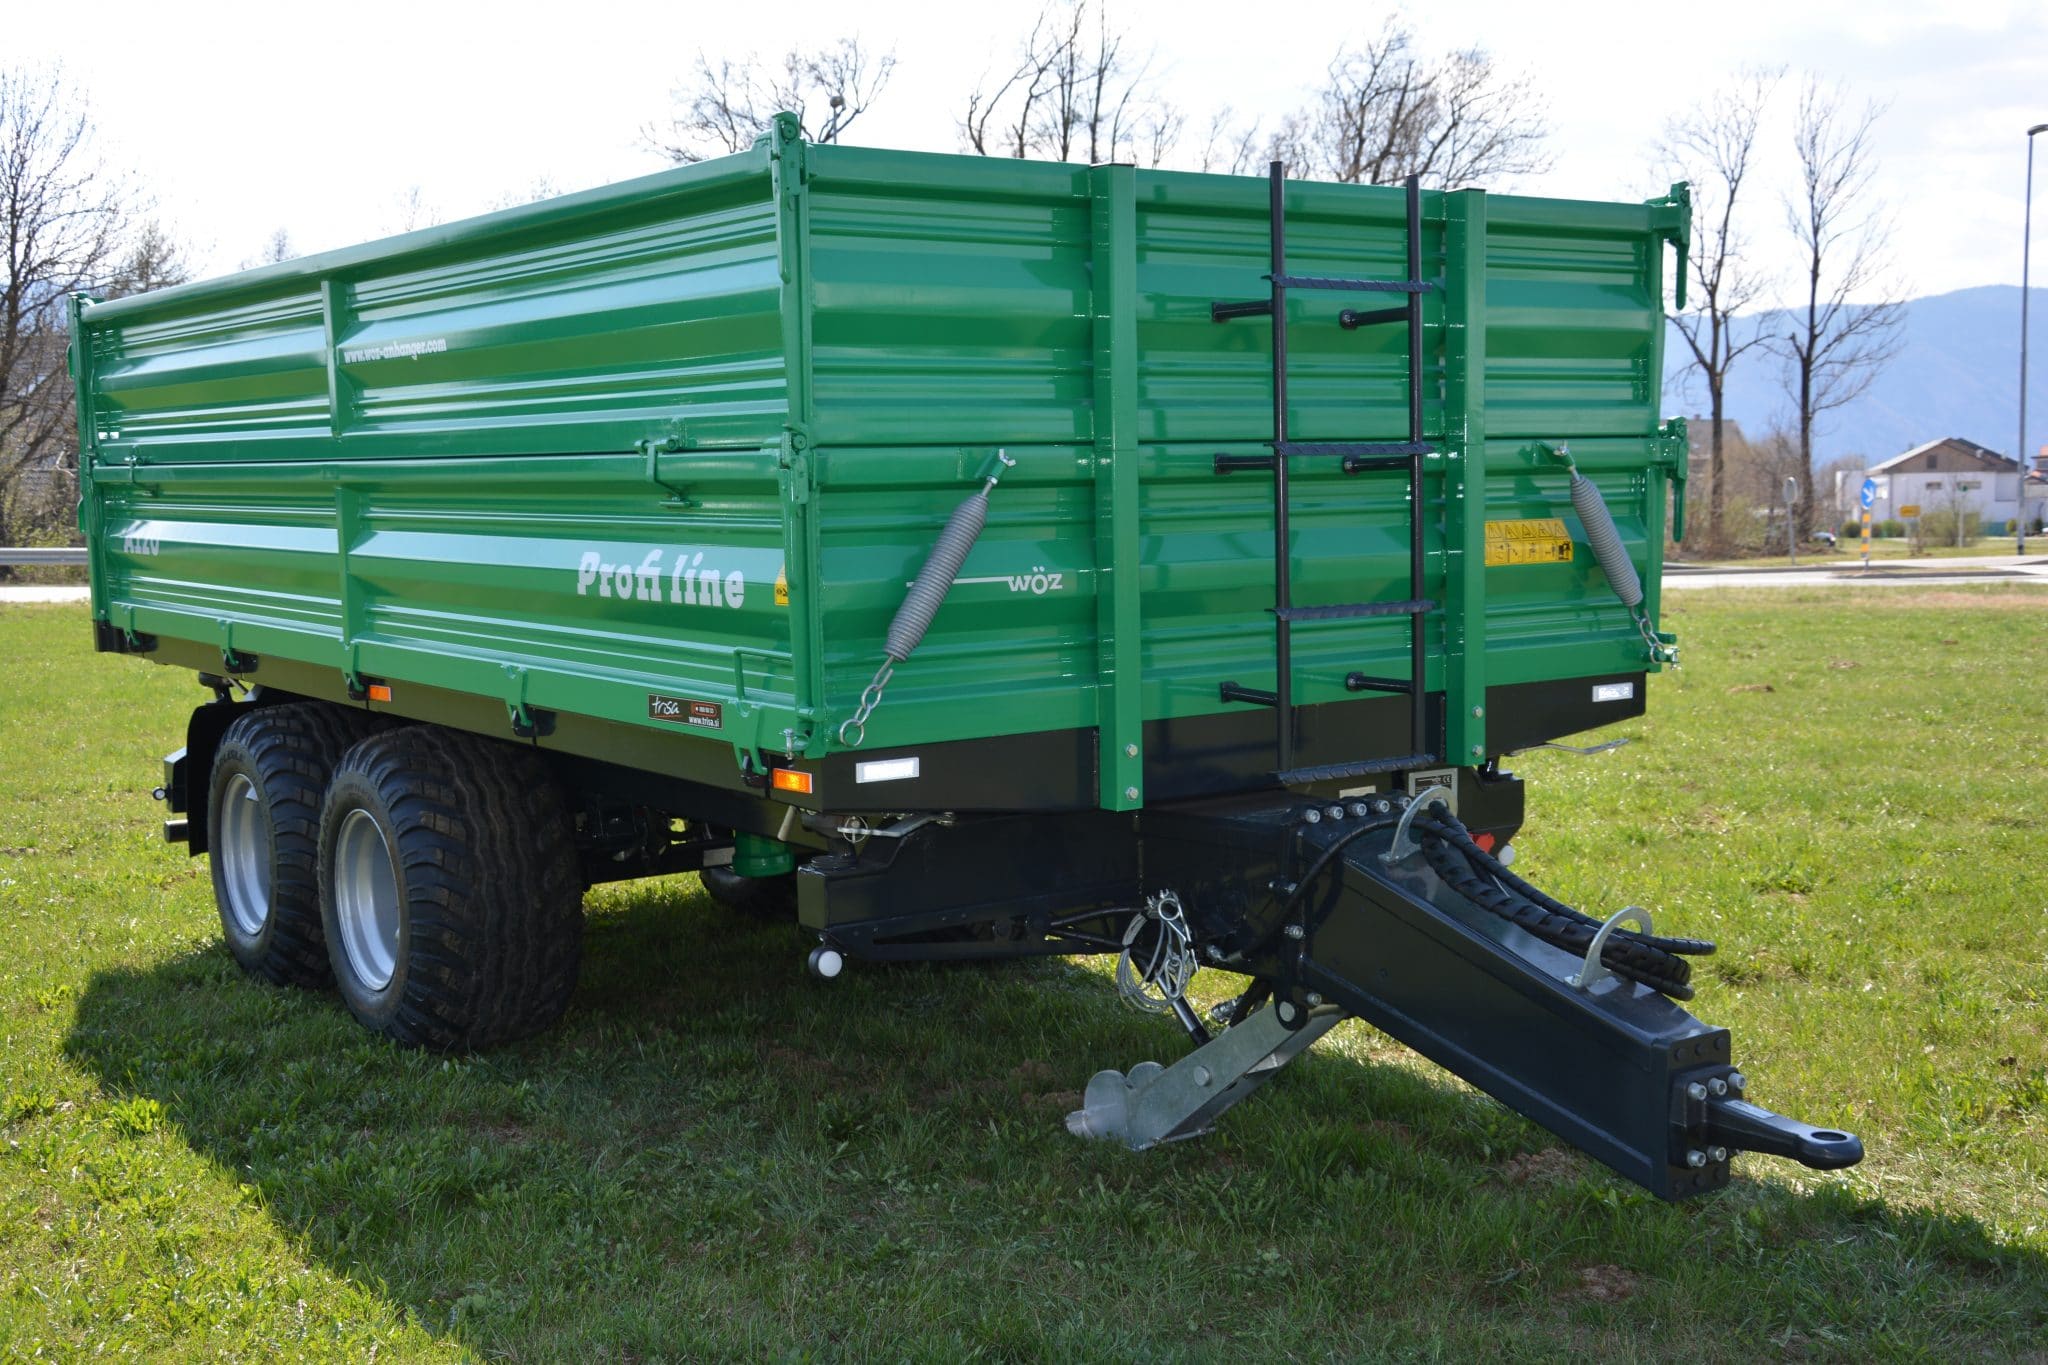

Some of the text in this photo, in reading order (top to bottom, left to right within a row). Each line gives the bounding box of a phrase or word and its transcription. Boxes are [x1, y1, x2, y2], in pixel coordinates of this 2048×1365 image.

[577, 549, 745, 608] Profi line
[689, 716, 720, 728] www.trisa.si
